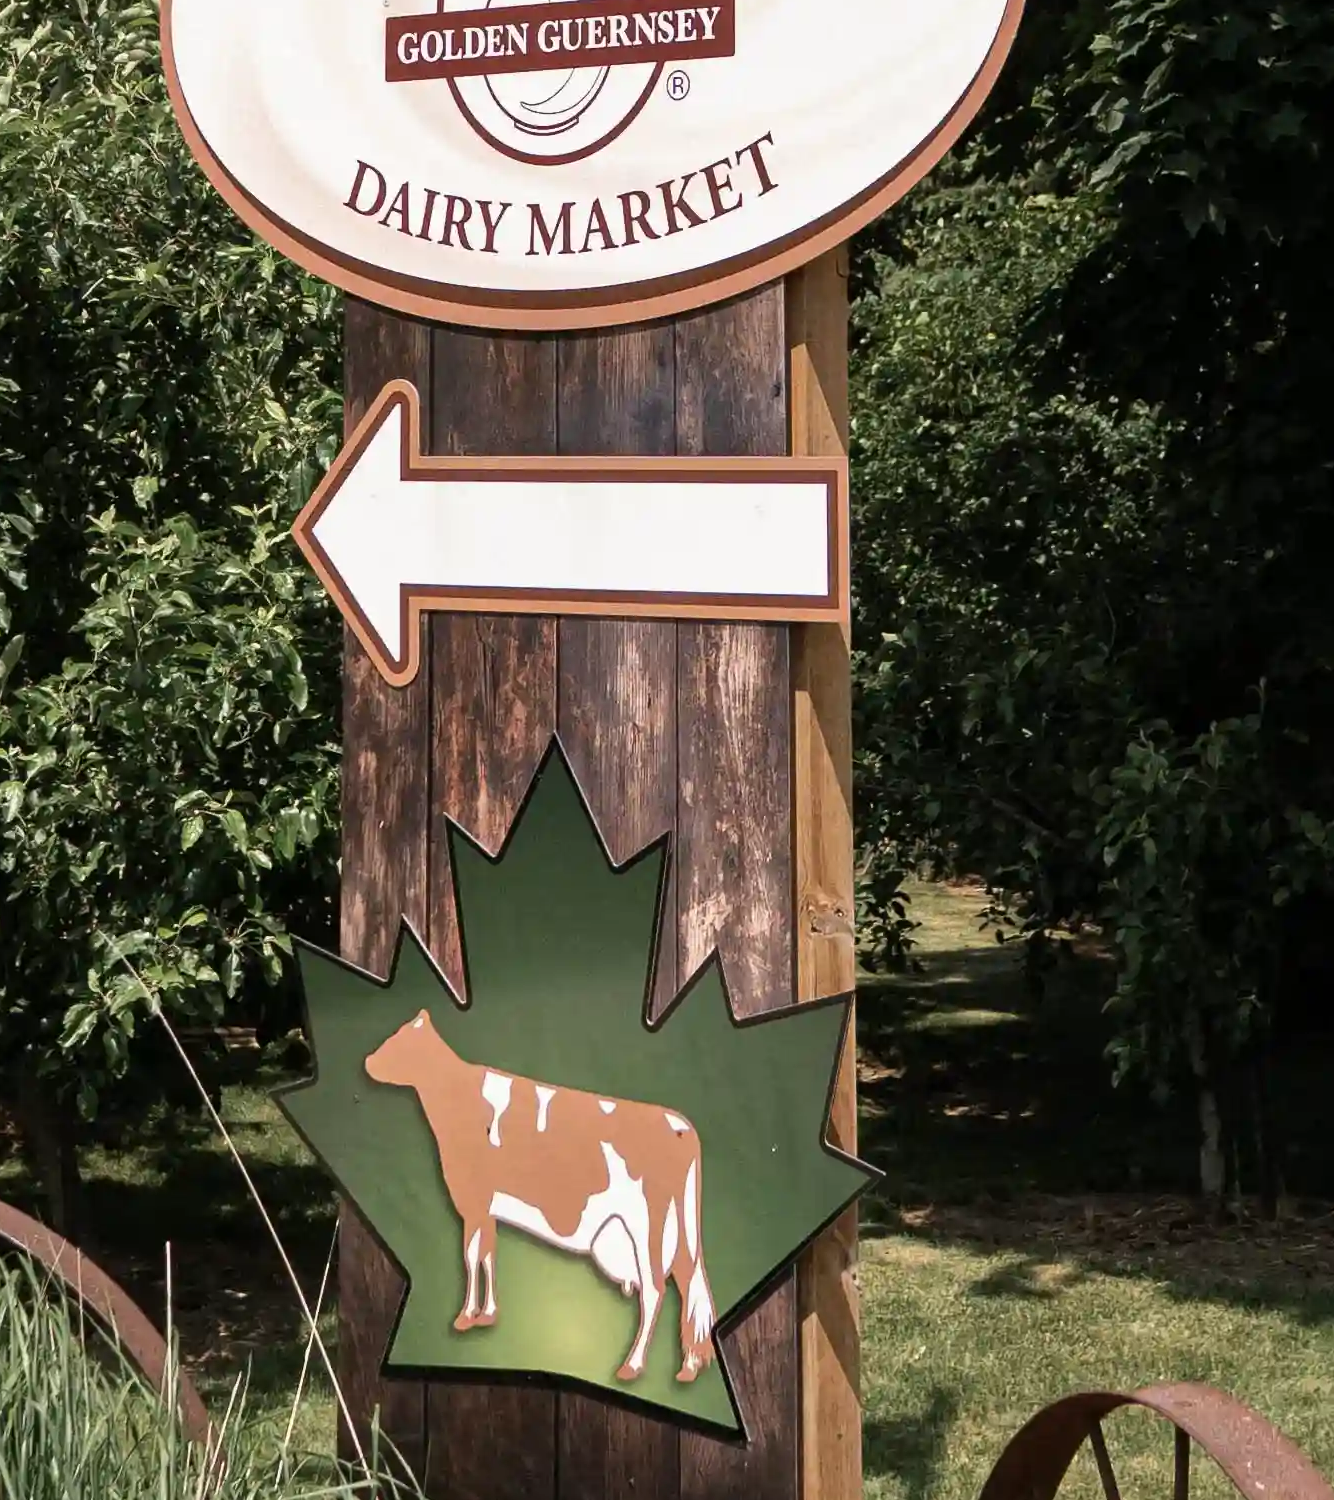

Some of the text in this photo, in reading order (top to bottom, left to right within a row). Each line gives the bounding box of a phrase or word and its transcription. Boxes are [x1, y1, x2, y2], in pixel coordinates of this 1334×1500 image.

[397, 6, 722, 65] GOLDEN GUERNSEY
[343, 132, 778, 256] DAIRY MARKET
